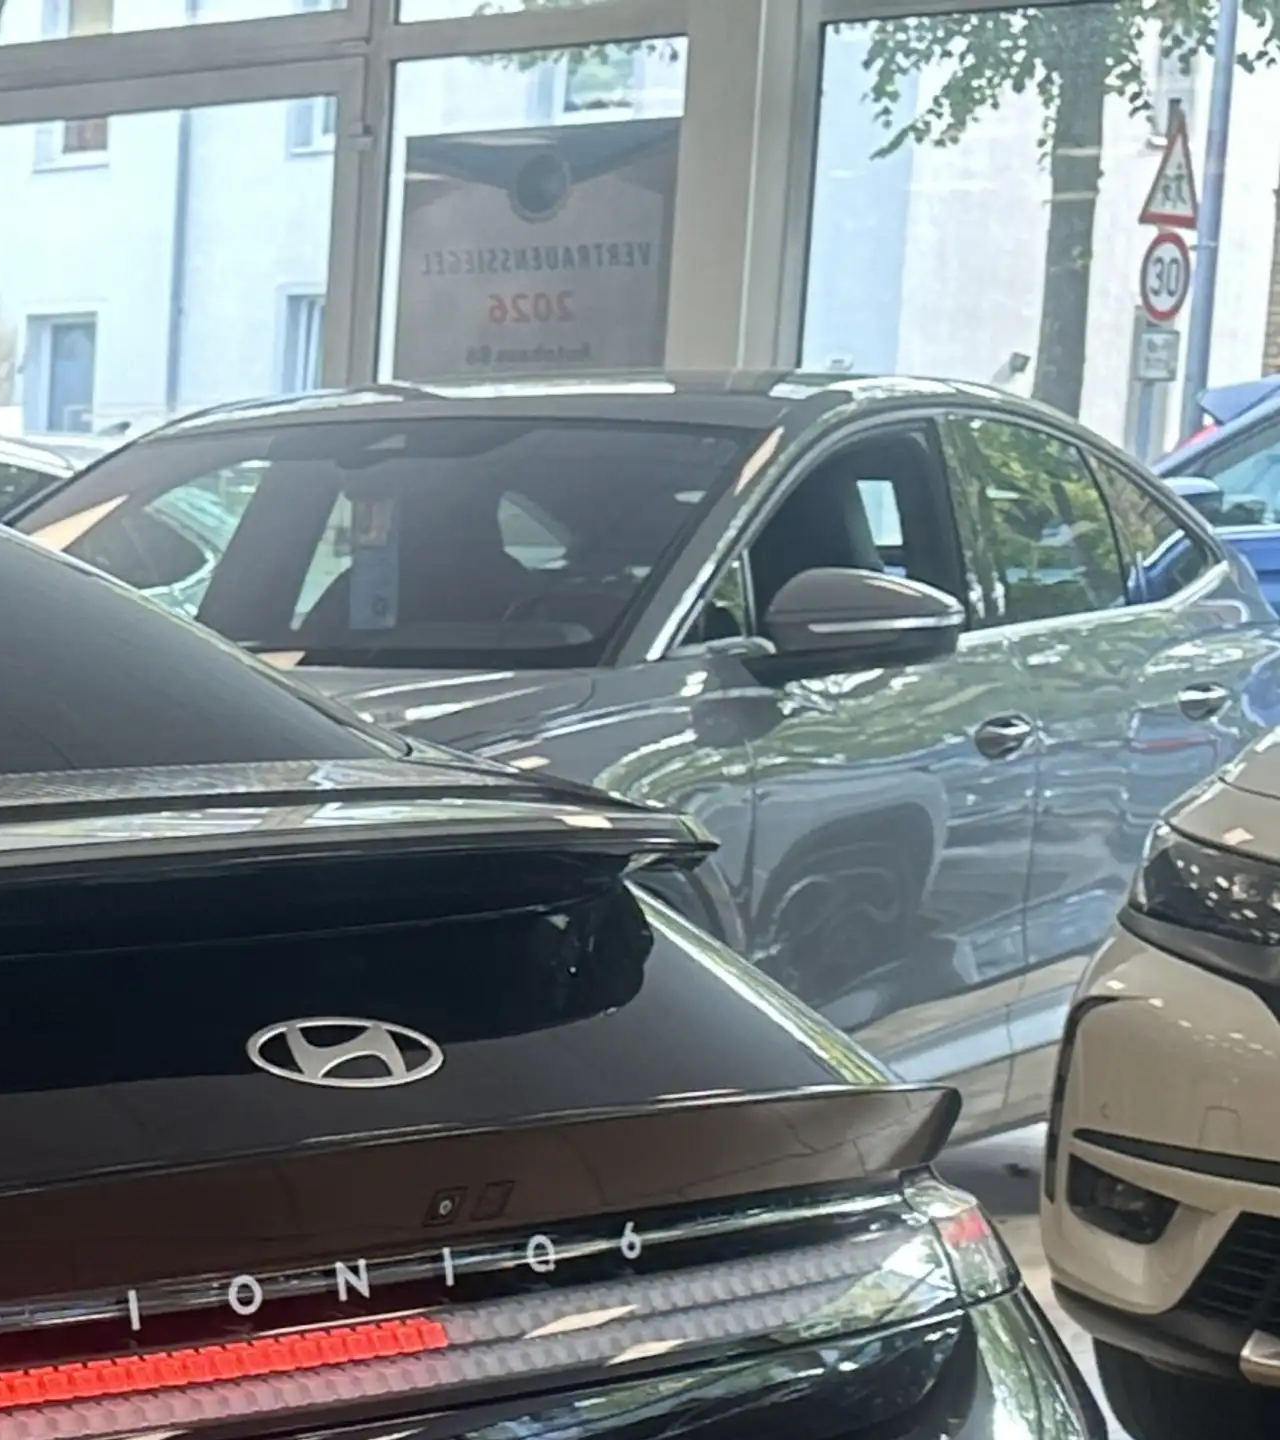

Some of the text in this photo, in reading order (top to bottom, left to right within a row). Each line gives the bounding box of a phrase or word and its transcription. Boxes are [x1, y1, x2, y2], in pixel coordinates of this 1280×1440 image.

[1149, 256, 1181, 298] 30
[127, 1221, 642, 1331] IONIQ 6
